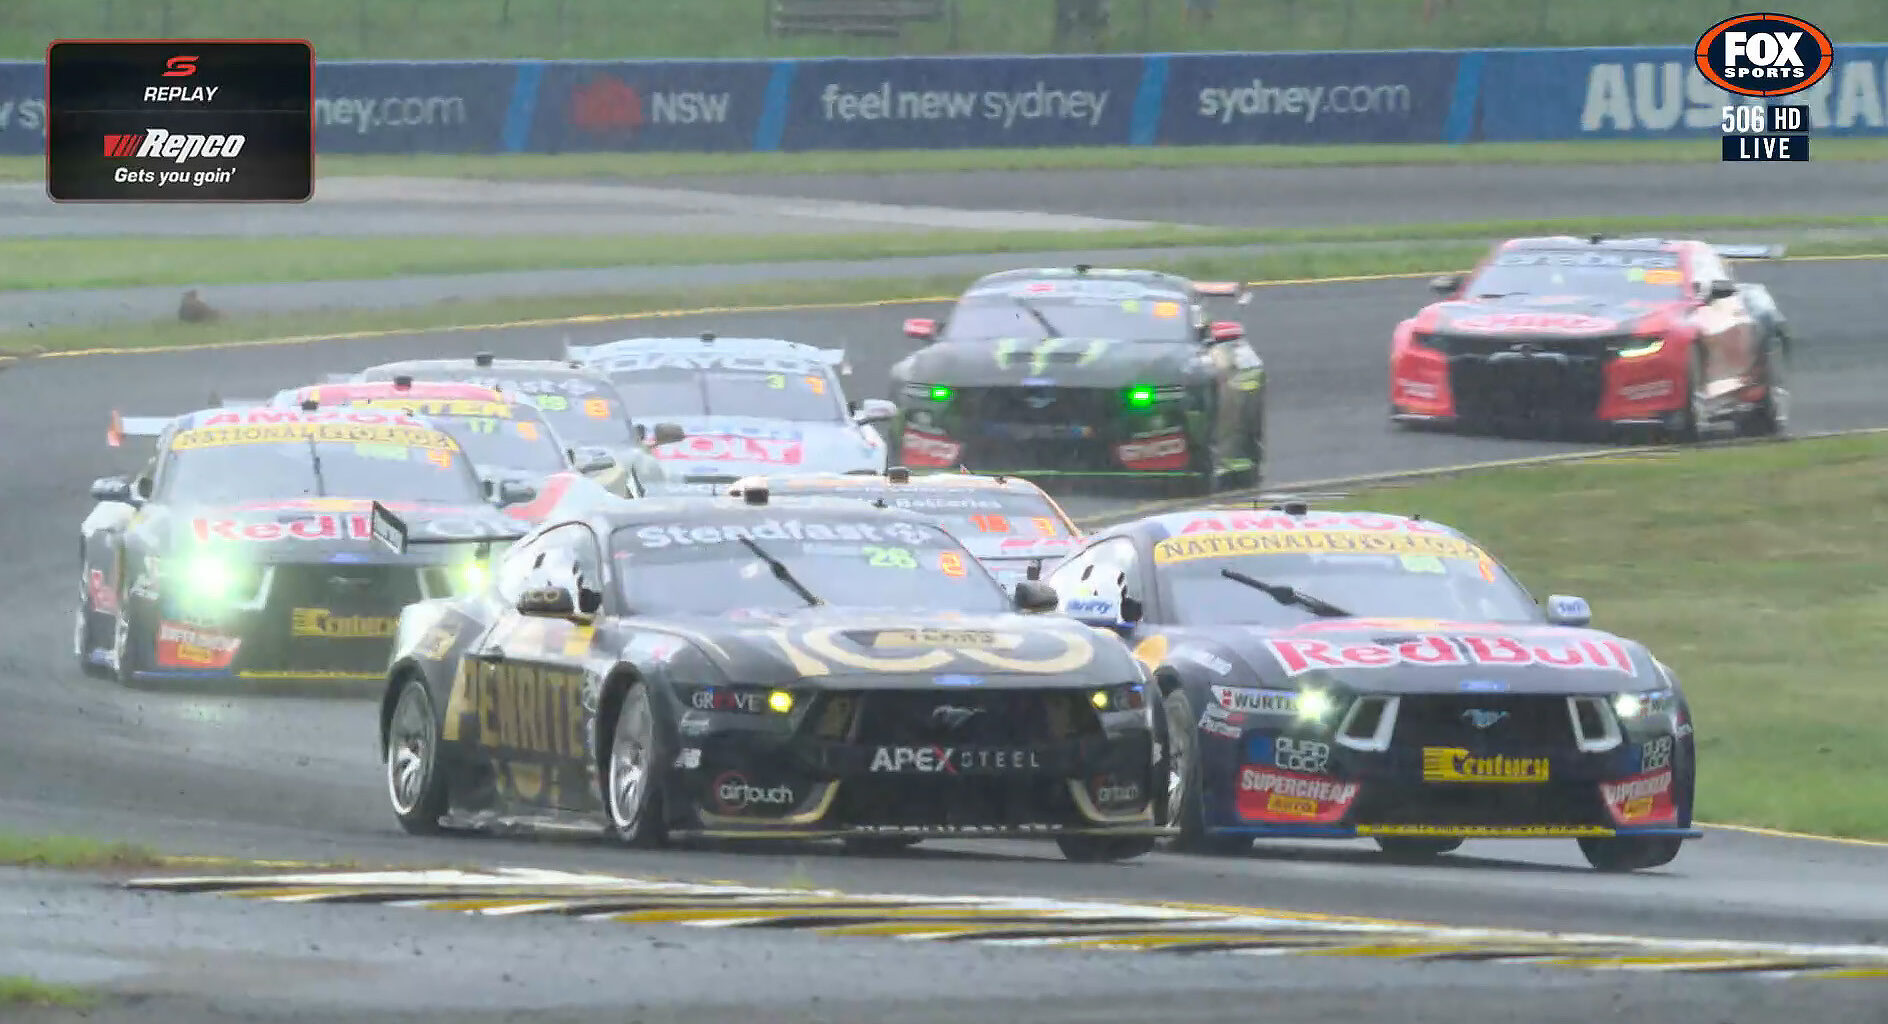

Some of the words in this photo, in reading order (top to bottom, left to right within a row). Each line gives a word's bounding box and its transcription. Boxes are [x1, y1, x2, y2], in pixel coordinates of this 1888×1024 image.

[651, 92, 730, 124] NSW
[821, 82, 891, 121] feel
[899, 92, 977, 120] new
[982, 81, 1109, 128] sydney
[1199, 79, 1411, 124] sydney.com
[1160, 530, 1324, 560] NATIONAL
[443, 655, 584, 758] PENRITE
[869, 746, 957, 774] APEX
[961, 751, 1041, 768] STEEL
[1430, 747, 1549, 782] Century
[1240, 769, 1355, 804] SUPERCHEAP
